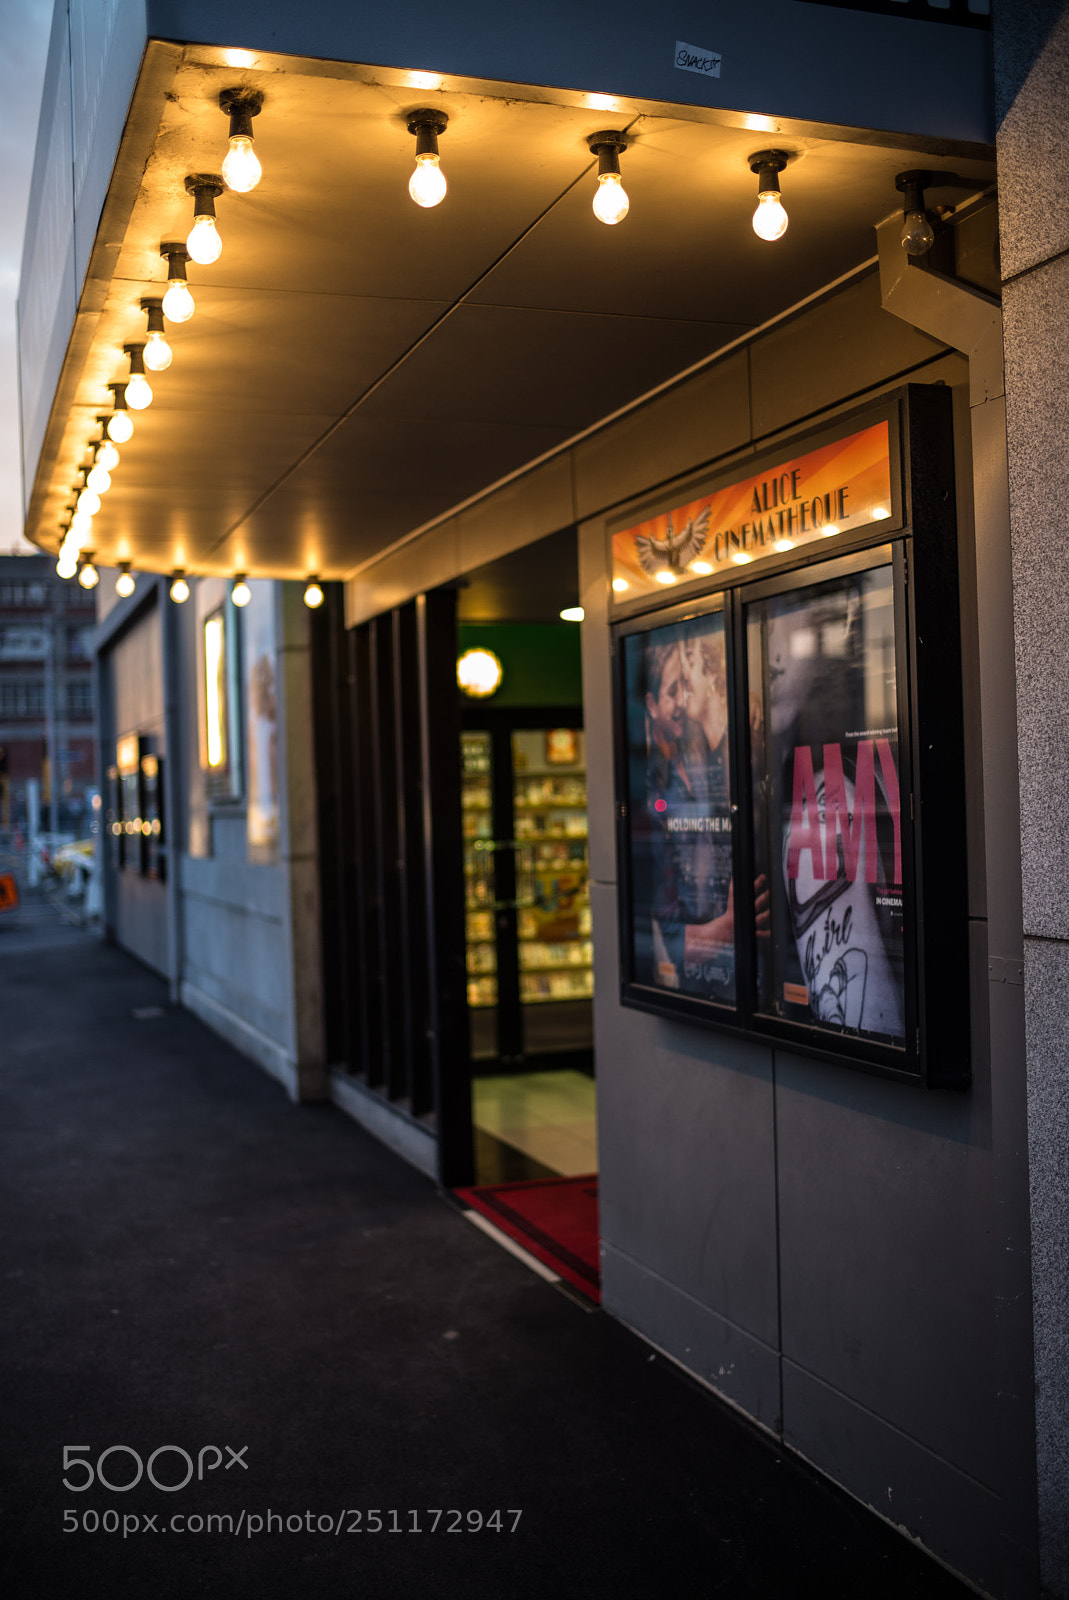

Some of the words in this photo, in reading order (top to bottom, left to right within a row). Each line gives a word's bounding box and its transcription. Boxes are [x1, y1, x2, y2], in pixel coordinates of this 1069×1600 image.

[751, 468, 801, 515] ALICE
[714, 486, 850, 562] CINEMATHEQUE
[668, 818, 703, 831] HOLDING
[705, 818, 720, 831] THE
